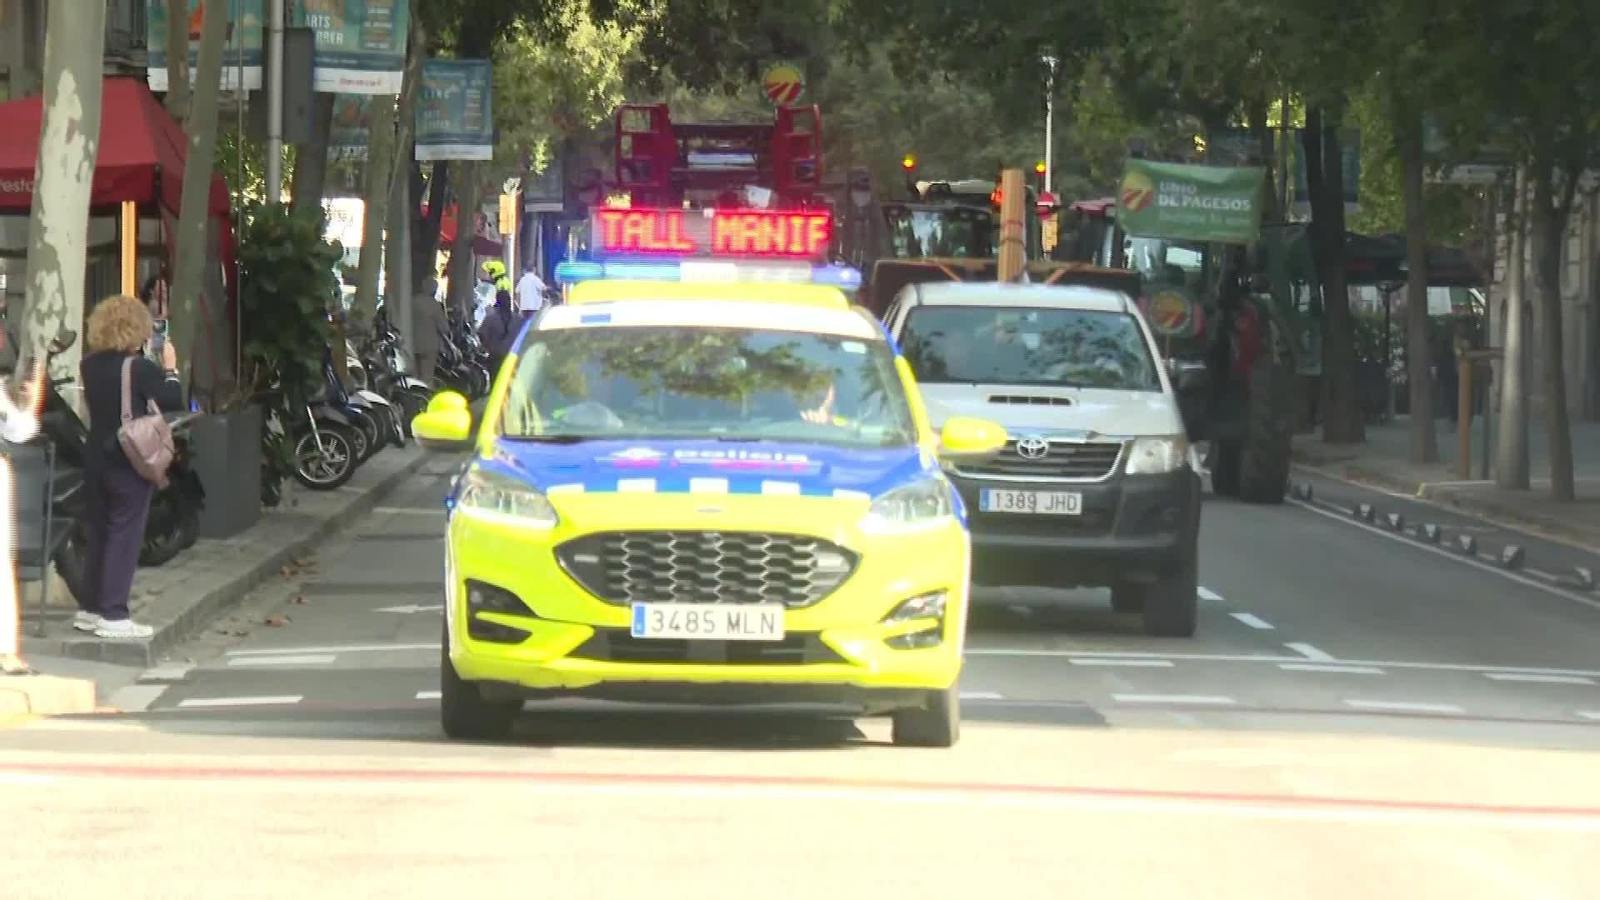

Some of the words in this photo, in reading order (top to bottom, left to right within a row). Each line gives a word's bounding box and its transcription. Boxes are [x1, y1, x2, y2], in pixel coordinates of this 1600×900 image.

[1158, 194, 1179, 208] DE
[1182, 195, 1252, 211] PAGESOS
[600, 211, 696, 251] TALL
[714, 213, 828, 254] MANIF
[995, 492, 1037, 509] 1389
[1044, 494, 1078, 511] JHD
[651, 609, 716, 634] 3485
[726, 611, 775, 634] MLN
